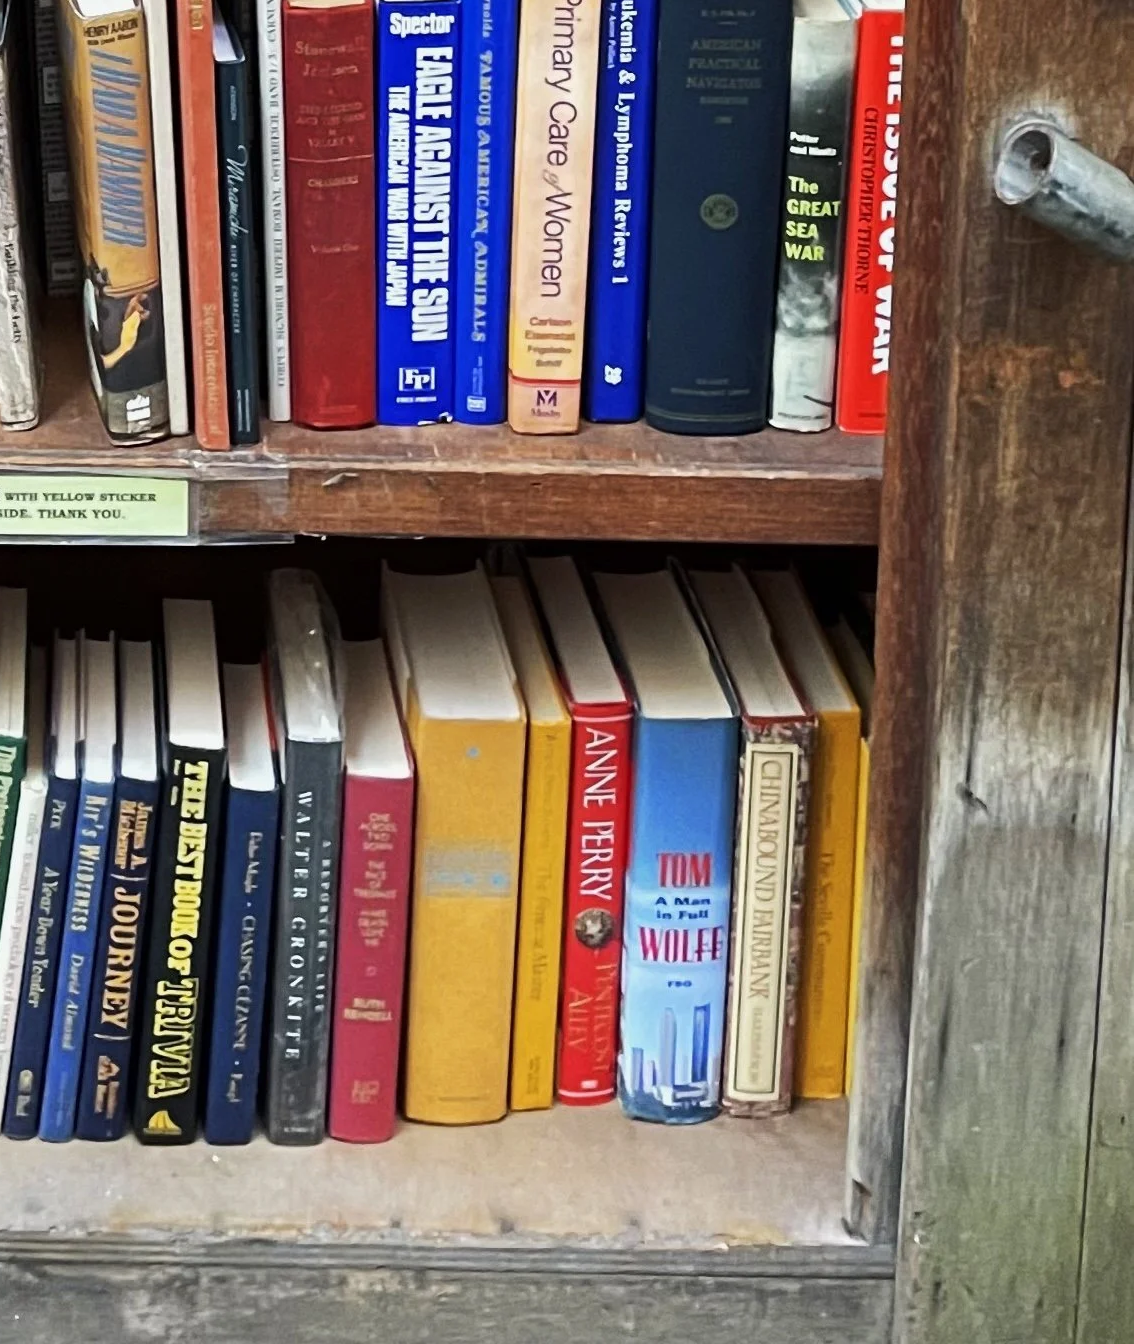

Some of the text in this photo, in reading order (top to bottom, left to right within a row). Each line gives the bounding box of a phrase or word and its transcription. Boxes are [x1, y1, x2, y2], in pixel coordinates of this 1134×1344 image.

[390, 13, 453, 35] Spector
[619, 69, 637, 84] &
[548, 101, 577, 166] Care
[613, 93, 636, 191] Lymphoma
[385, 86, 410, 306] THE AMERICAN WAR WITH JAPAN
[412, 48, 453, 341] EAGLE AGAINST THE SUN
[542, 171, 571, 194] of
[541, 193, 571, 298] Women
[613, 199, 632, 268] Reviews
[611, 275, 629, 283] 1
[5, 492, 38, 501] WITH
[43, 492, 95, 501] YELLOW
[100, 493, 156, 502] STICKER
[38, 509, 87, 519] THANK
[92, 509, 126, 519] YOU.
[580, 727, 616, 901] ANNE PERRY
[748, 760, 782, 1000] CHINABOUND FAIRBANK
[100, 886, 141, 1029] JOURNEY
